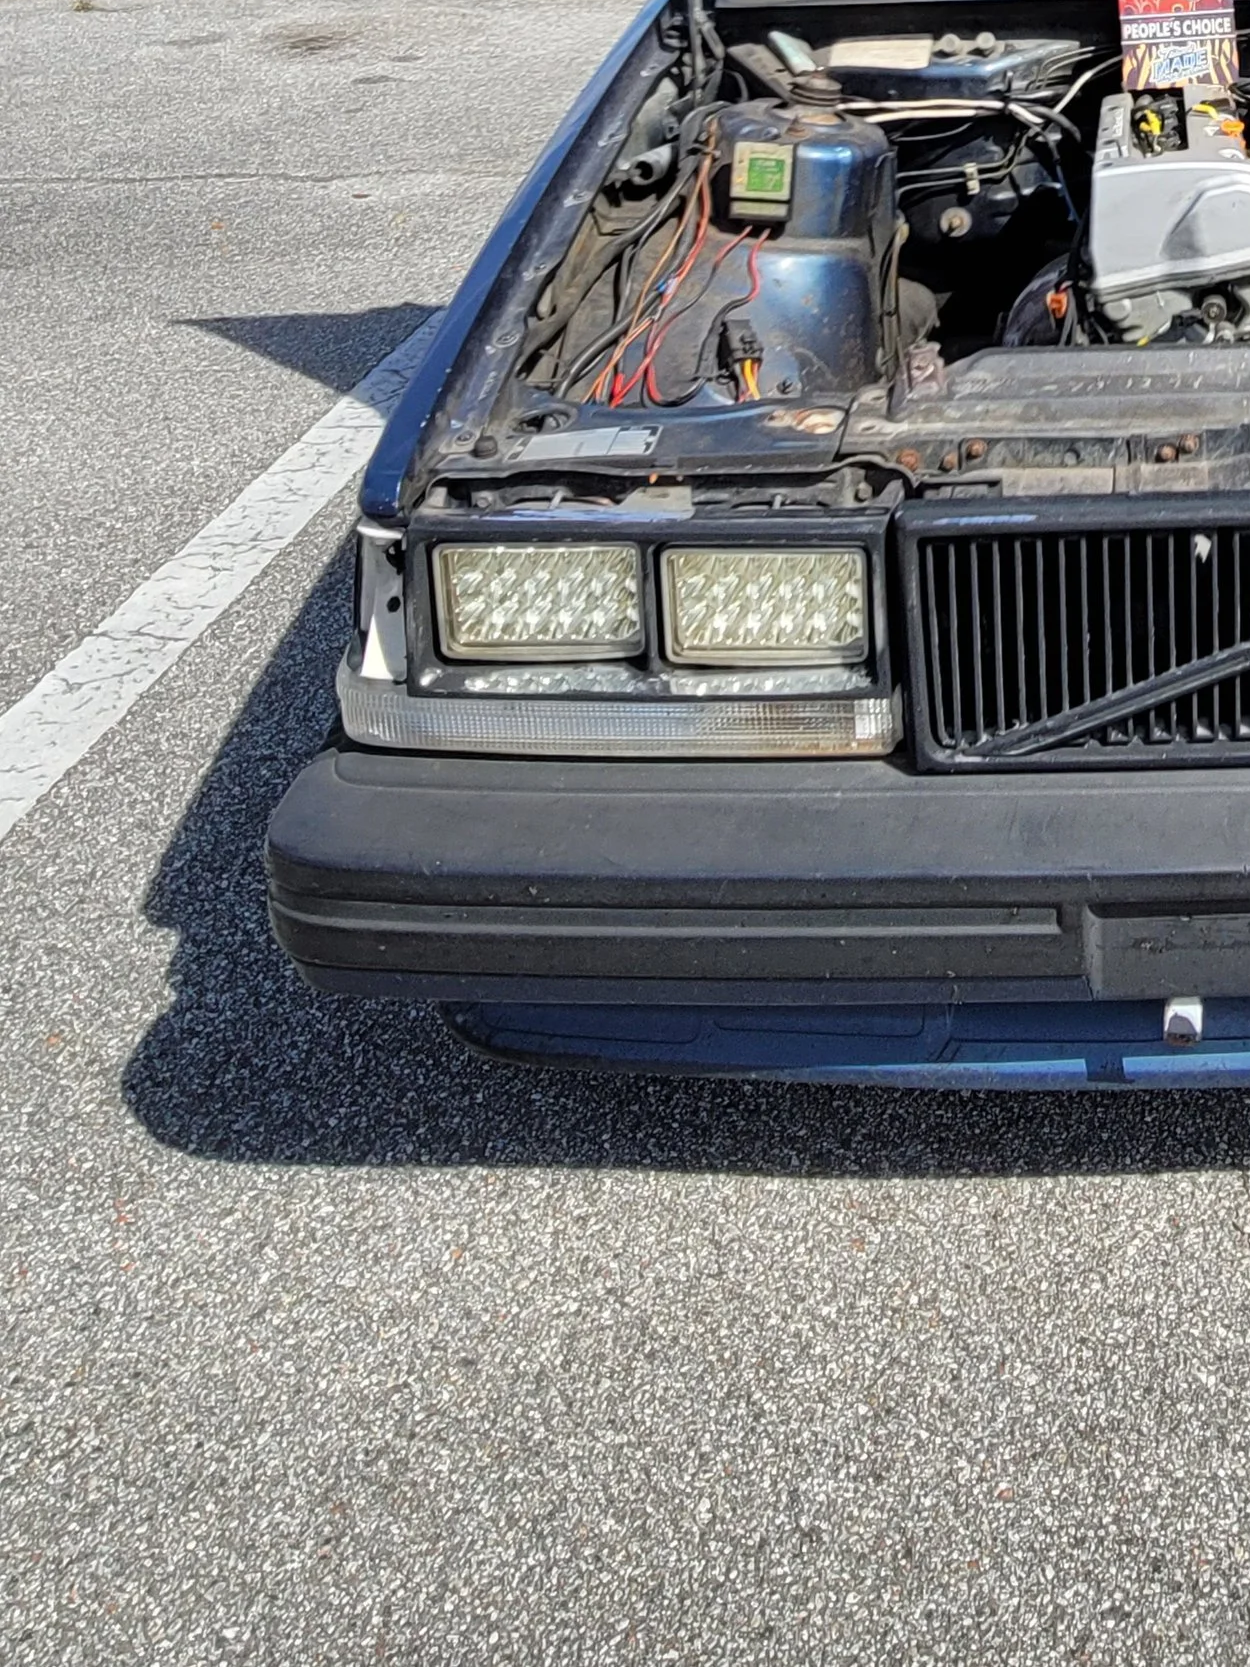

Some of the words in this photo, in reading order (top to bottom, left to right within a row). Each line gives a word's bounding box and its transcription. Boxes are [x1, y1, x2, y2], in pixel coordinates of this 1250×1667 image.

[1123, 20, 1181, 39] PEOPLE'S
[1183, 17, 1231, 35] CHOICE
[1154, 49, 1207, 79] MADE
